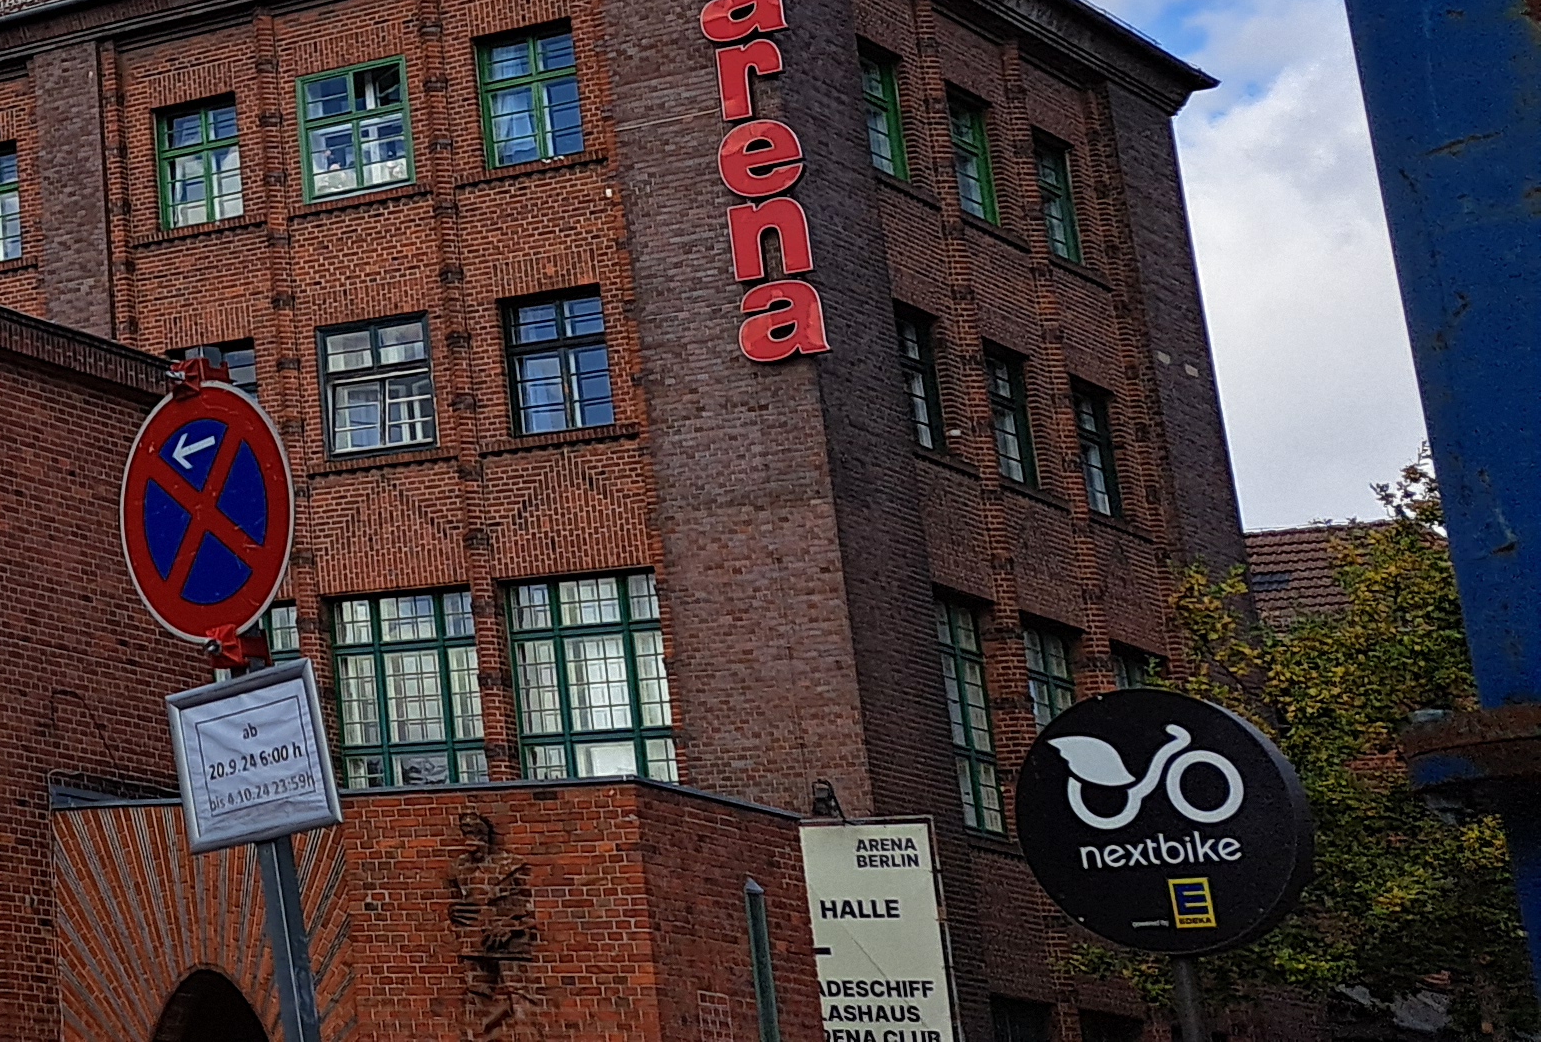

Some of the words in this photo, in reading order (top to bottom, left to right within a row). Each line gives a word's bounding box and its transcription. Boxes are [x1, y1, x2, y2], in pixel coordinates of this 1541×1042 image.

[242, 723, 258, 740] ab
[208, 754, 257, 781] 20.9.24
[259, 744, 289, 767] 6:00
[291, 741, 303, 759] h
[210, 797, 226, 812] bis
[227, 785, 270, 806] 4.10.24
[856, 838, 917, 853] ARENA
[1079, 830, 1243, 870] nextbike
[856, 854, 920, 869] BERLIN
[820, 899, 901, 919] HALLE
